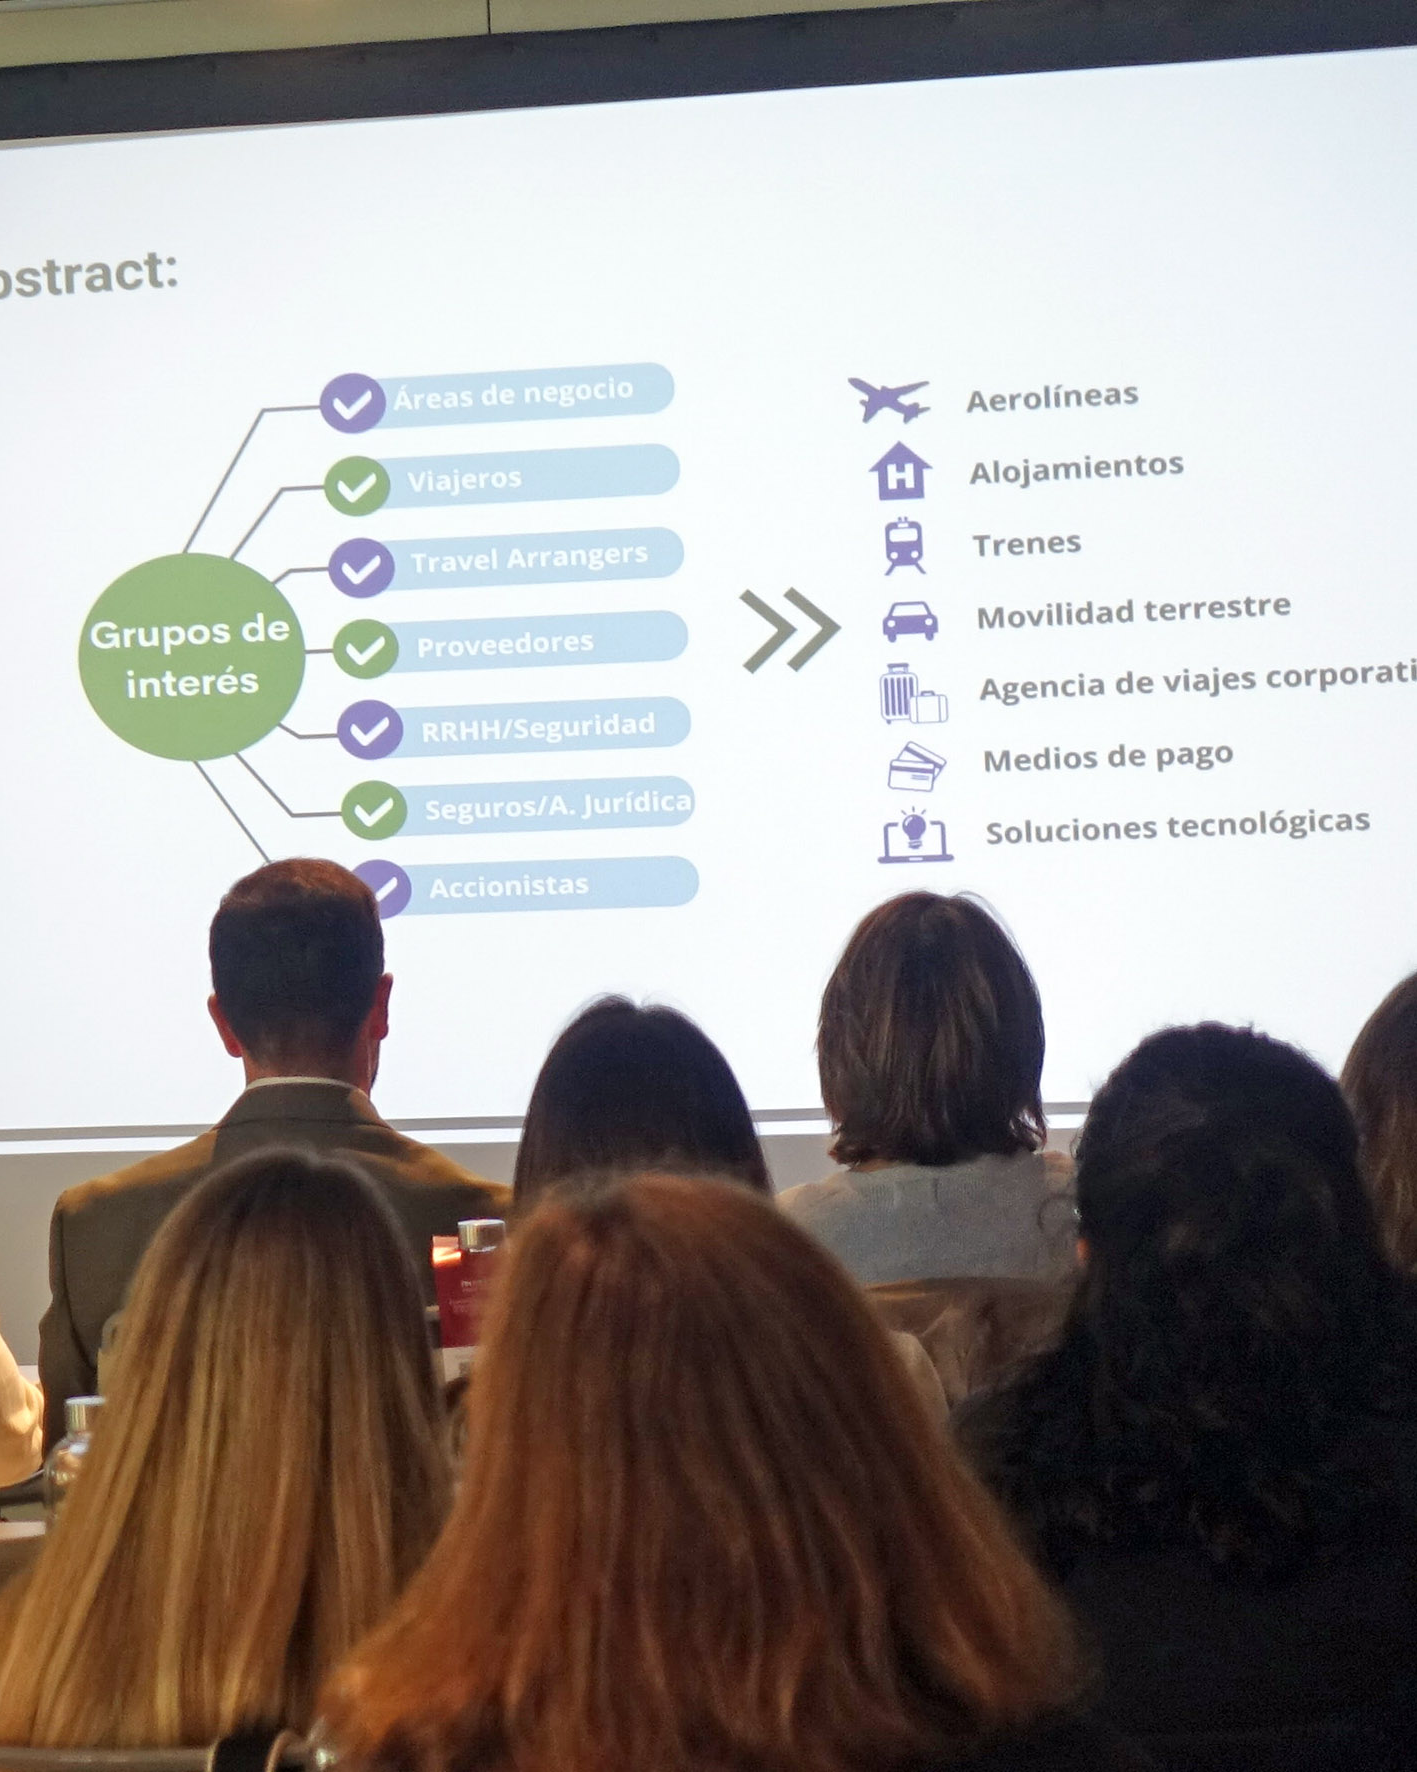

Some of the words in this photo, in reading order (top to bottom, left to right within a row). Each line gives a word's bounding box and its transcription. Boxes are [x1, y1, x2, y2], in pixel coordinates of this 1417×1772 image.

[393, 384, 474, 411] Áreas
[481, 383, 516, 406] de
[524, 376, 634, 408] negocio
[966, 384, 1140, 414] Aerolíneas
[407, 468, 523, 497] Viajeros
[969, 453, 1185, 489] Alojamientos
[411, 548, 499, 573] Travel
[506, 546, 650, 572] Arrangers
[972, 532, 1083, 558] Trenes
[977, 598, 1135, 630] Movilidad
[1143, 595, 1292, 623] terrestre
[90, 620, 232, 656] Grupos
[241, 611, 291, 643] de
[418, 630, 595, 658] Proveedores
[126, 664, 260, 699] interés
[979, 672, 1106, 707] Agencia
[1115, 670, 1155, 695] de
[1162, 665, 1258, 698] viajes
[422, 711, 655, 744] RRHH/Seguridad
[984, 744, 1099, 773] Medios
[1107, 743, 1147, 768] de
[1156, 744, 1235, 774] pago
[425, 795, 577, 825] Seguros/A.
[581, 790, 692, 820] Jurídica
[986, 815, 1159, 846] Soluciones
[1166, 807, 1372, 840] tecnológicas
[429, 874, 591, 899] Accionistas
